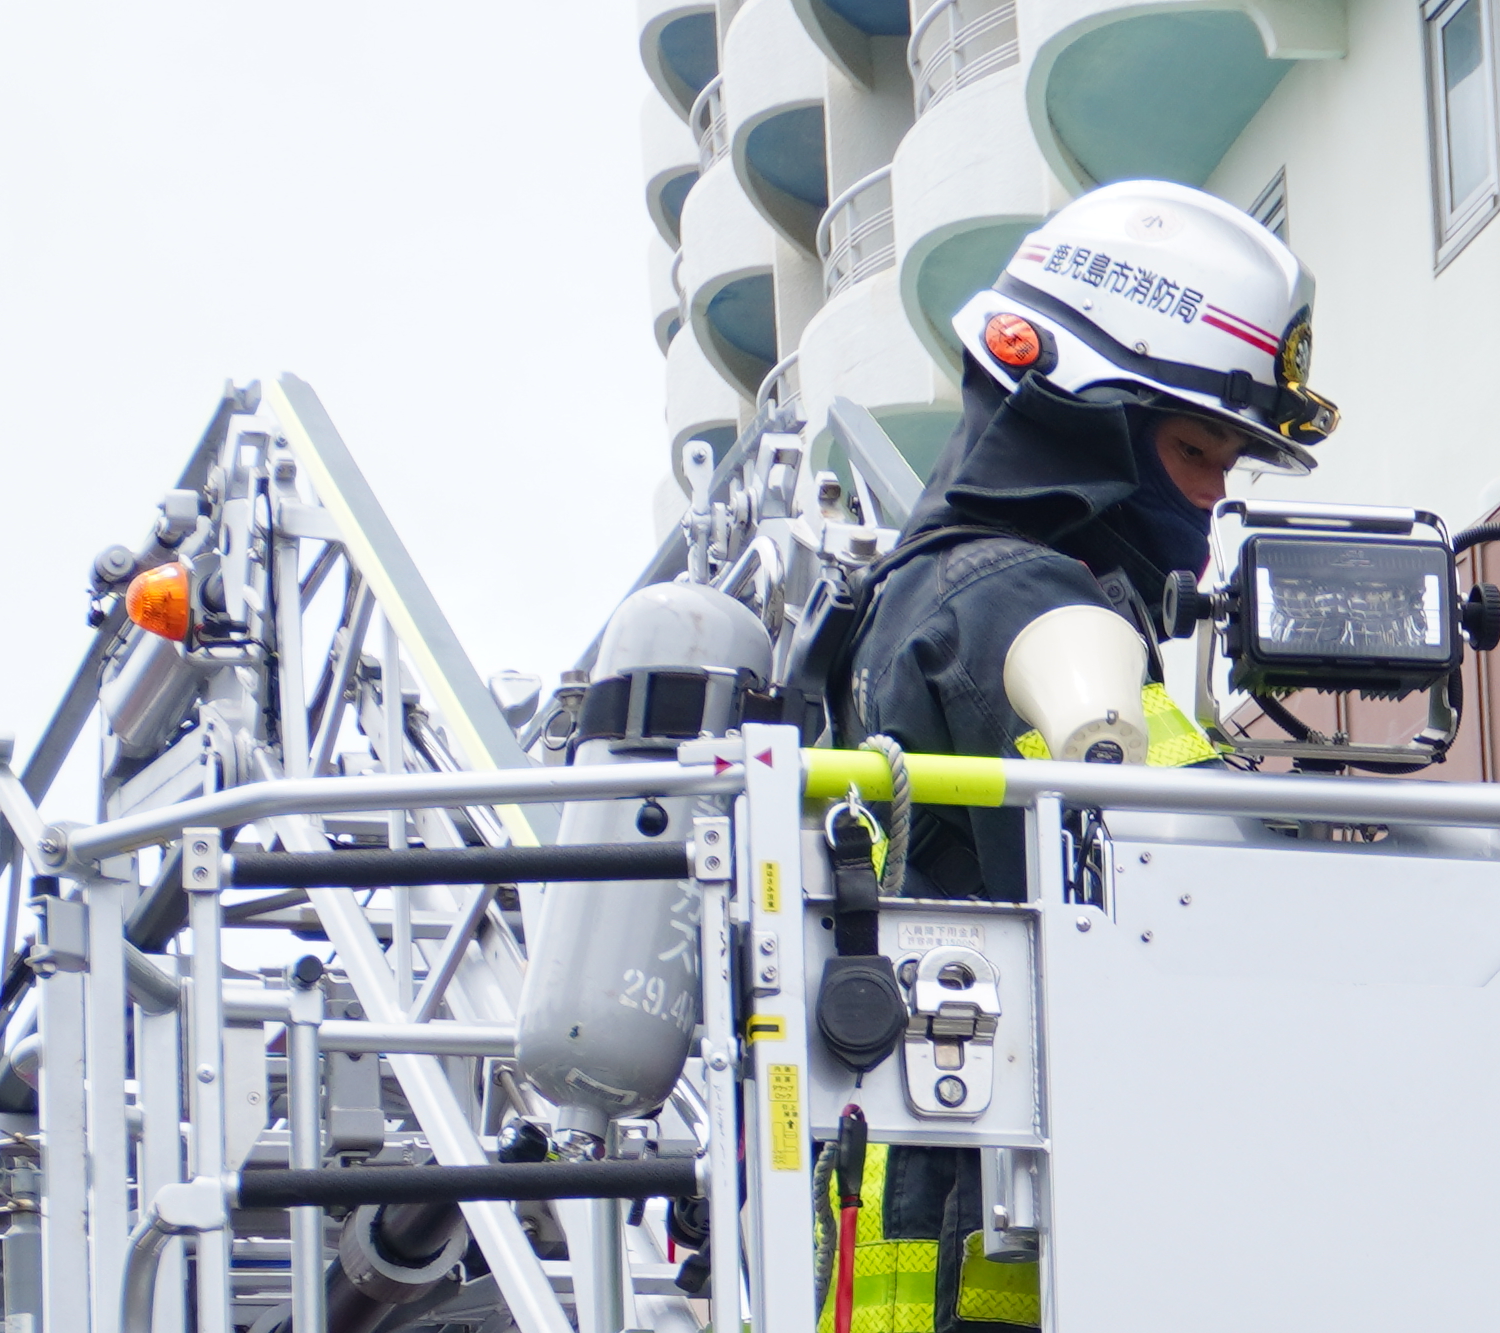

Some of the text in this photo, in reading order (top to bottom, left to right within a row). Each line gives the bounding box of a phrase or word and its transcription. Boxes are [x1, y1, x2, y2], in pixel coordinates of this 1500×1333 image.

[1043, 244, 1204, 324] 鹿児島市消防局
